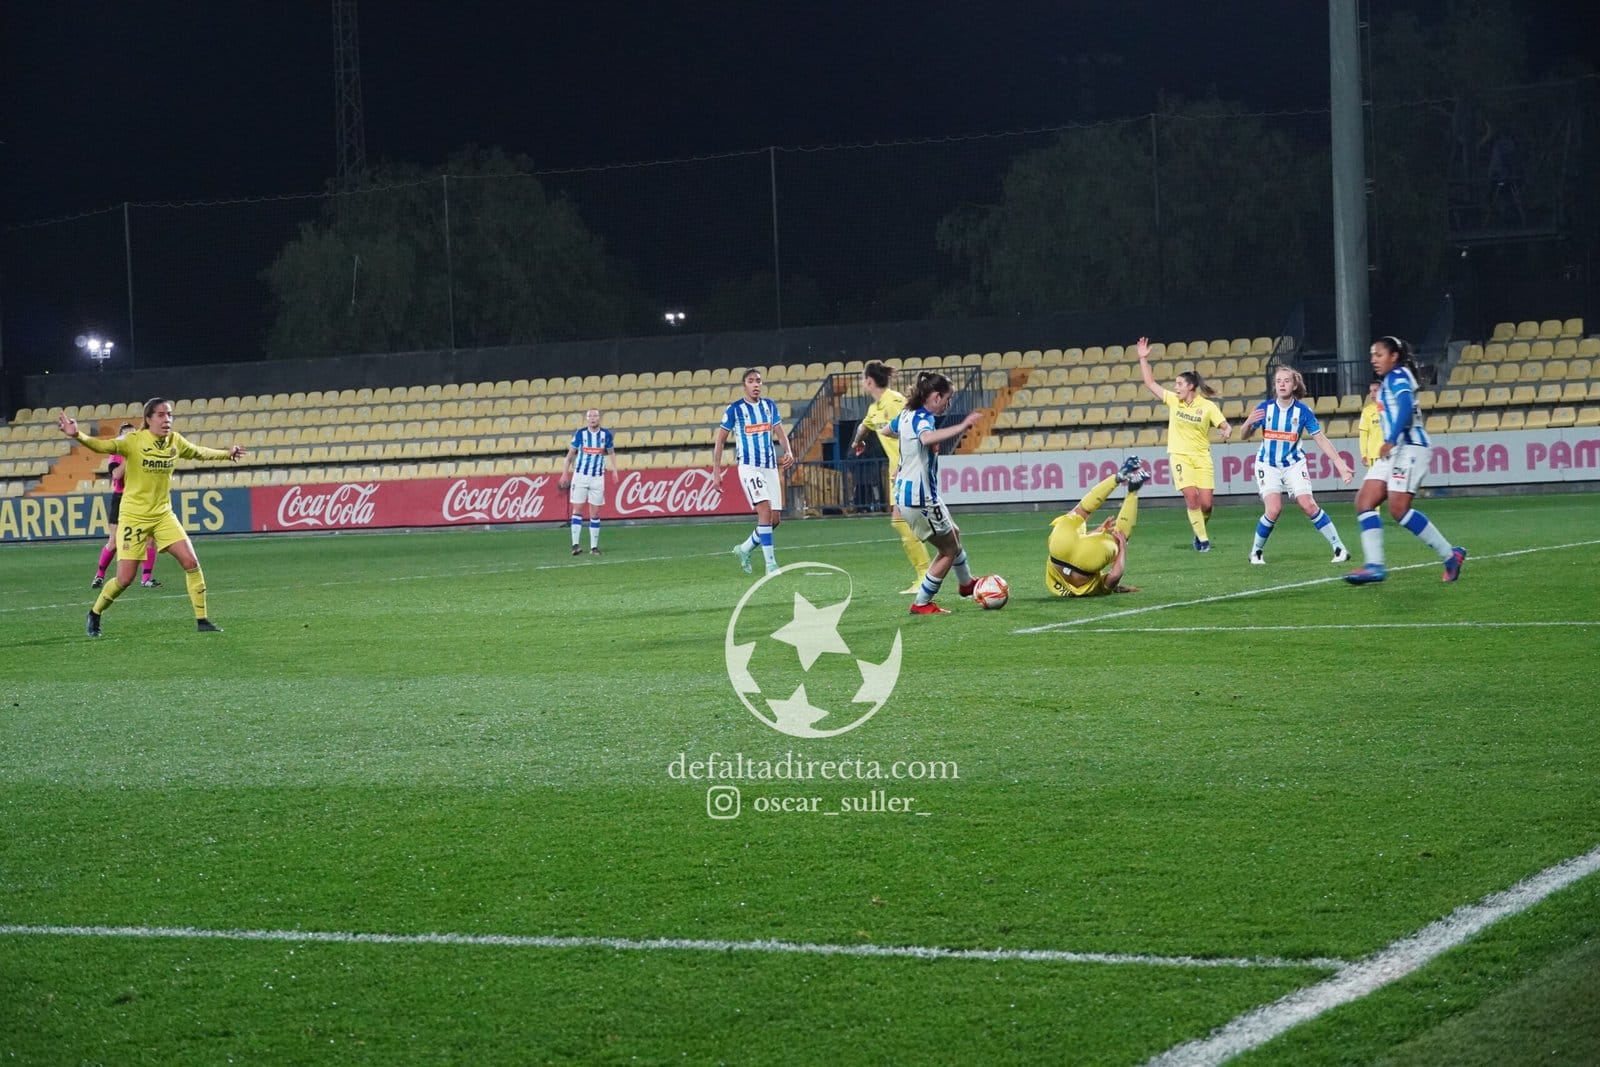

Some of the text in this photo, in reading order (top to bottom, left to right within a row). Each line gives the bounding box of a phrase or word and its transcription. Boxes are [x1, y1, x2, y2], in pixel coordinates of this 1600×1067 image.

[1175, 463, 1182, 475] 9
[1429, 443, 1509, 475] MESA
[615, 468, 728, 515] Coca-Cola
[750, 476, 763, 490] 16
[940, 463, 1063, 493] PAMESA
[277, 483, 380, 527] Coca-Cola
[442, 476, 549, 521] Coca-Cola
[934, 505, 943, 522] 8
